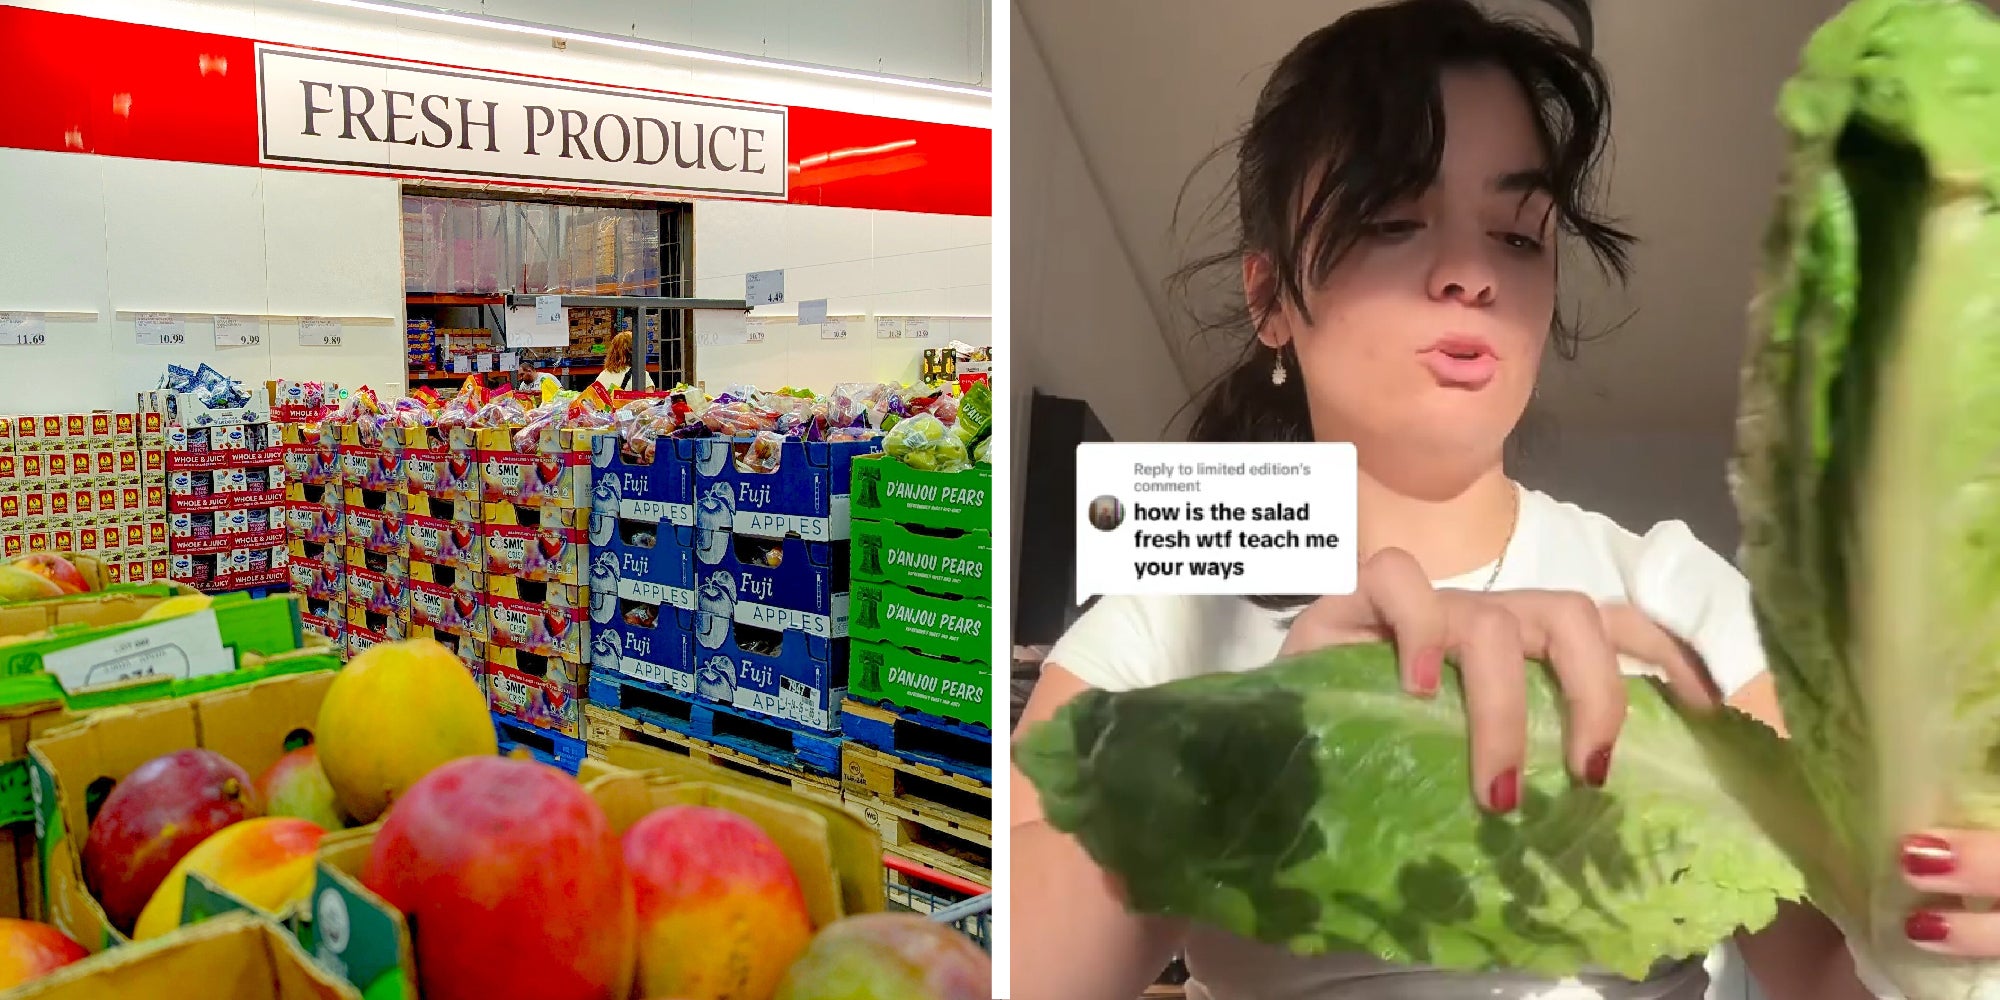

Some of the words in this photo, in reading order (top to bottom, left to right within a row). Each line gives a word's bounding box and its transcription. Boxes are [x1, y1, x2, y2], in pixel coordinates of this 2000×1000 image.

[299, 80, 502, 152] FRESH
[521, 104, 766, 174] PRODUCE
[768, 292, 784, 302] 4.49
[17, 334, 45, 344] 11.69
[160, 334, 184, 344] 10.99
[240, 335, 260, 345] 9.99
[324, 336, 341, 345] 9.89
[623, 472, 649, 496] Fuji
[739, 482, 771, 508] Fuji
[887, 480, 938, 501] D'ANJOU
[941, 486, 984, 507] PEARS
[634, 502, 688, 520] APPLES
[751, 515, 822, 536] APPLES
[622, 553, 649, 576] Fuji
[888, 548, 938, 570] D'ANJOU
[941, 556, 983, 578] PEARS
[632, 582, 688, 605] APPLES
[740, 572, 773, 600] Fuji
[753, 606, 824, 632] APPLES
[886, 603, 936, 628] D'ANJOU
[940, 614, 981, 636] PEARS
[626, 632, 650, 656] Fuji
[634, 662, 688, 688] APPLES
[740, 660, 773, 688] Fuji
[888, 667, 938, 692] D'ANJOU
[941, 680, 983, 702] PEARS
